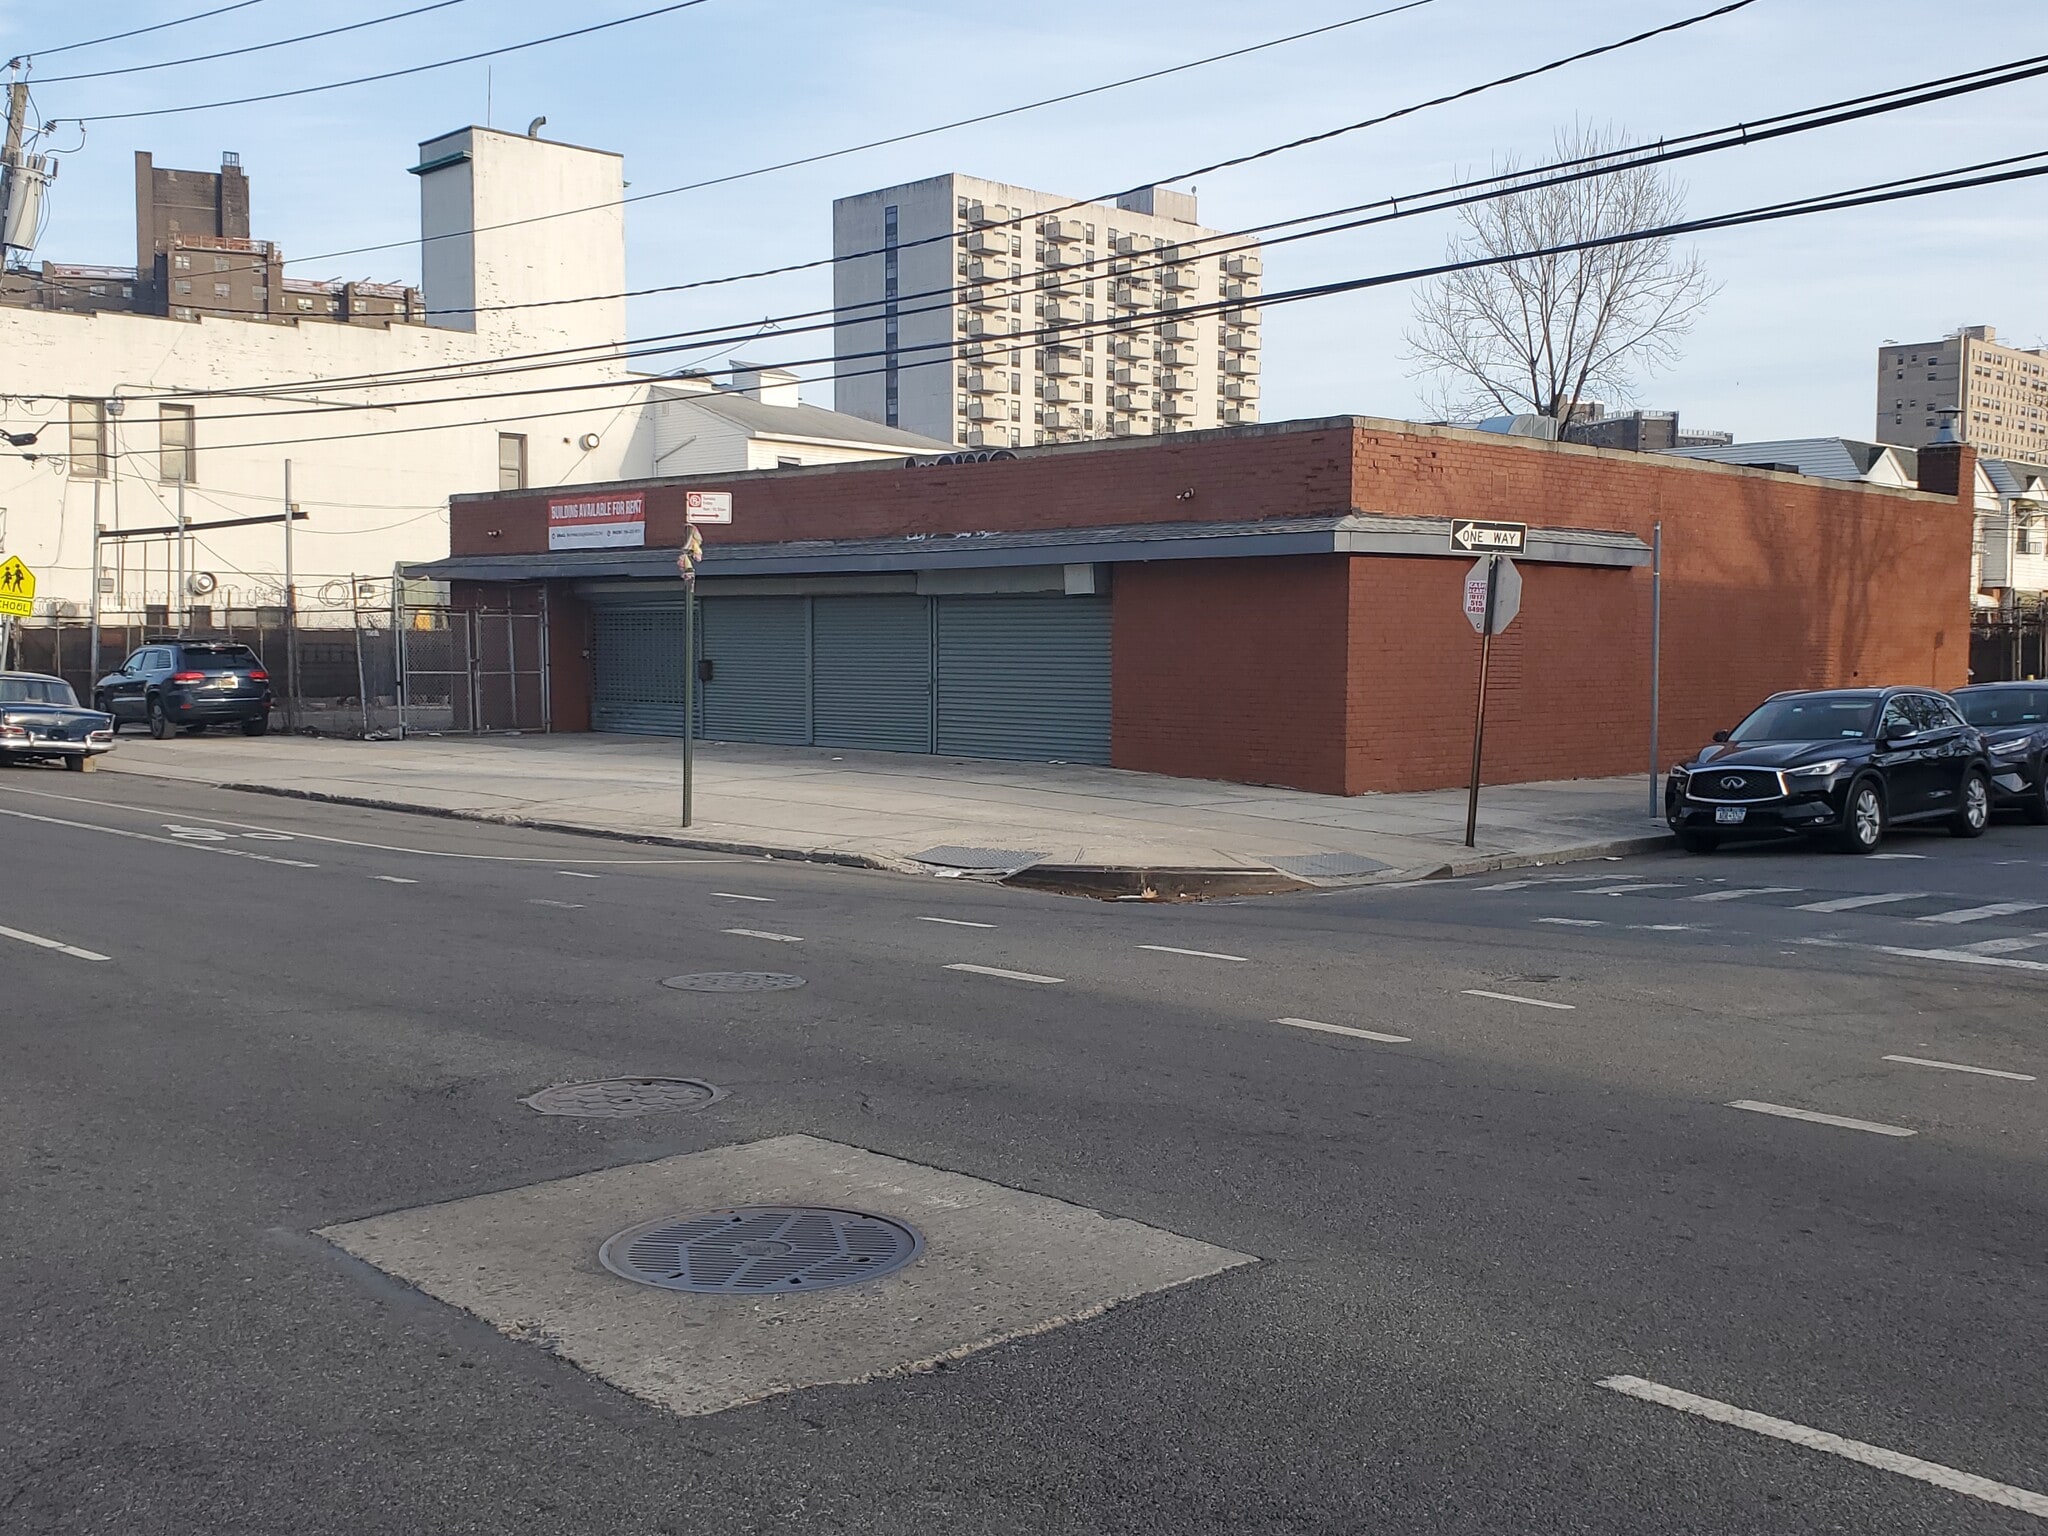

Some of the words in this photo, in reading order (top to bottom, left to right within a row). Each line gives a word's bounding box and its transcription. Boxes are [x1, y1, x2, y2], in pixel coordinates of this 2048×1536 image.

[551, 504, 578, 520] BUILDING
[578, 502, 612, 518] AVAILABLE
[612, 501, 625, 516] FOR
[625, 499, 643, 515] RENT
[1462, 530, 1484, 543] ONE
[1493, 532, 1516, 545] WAY
